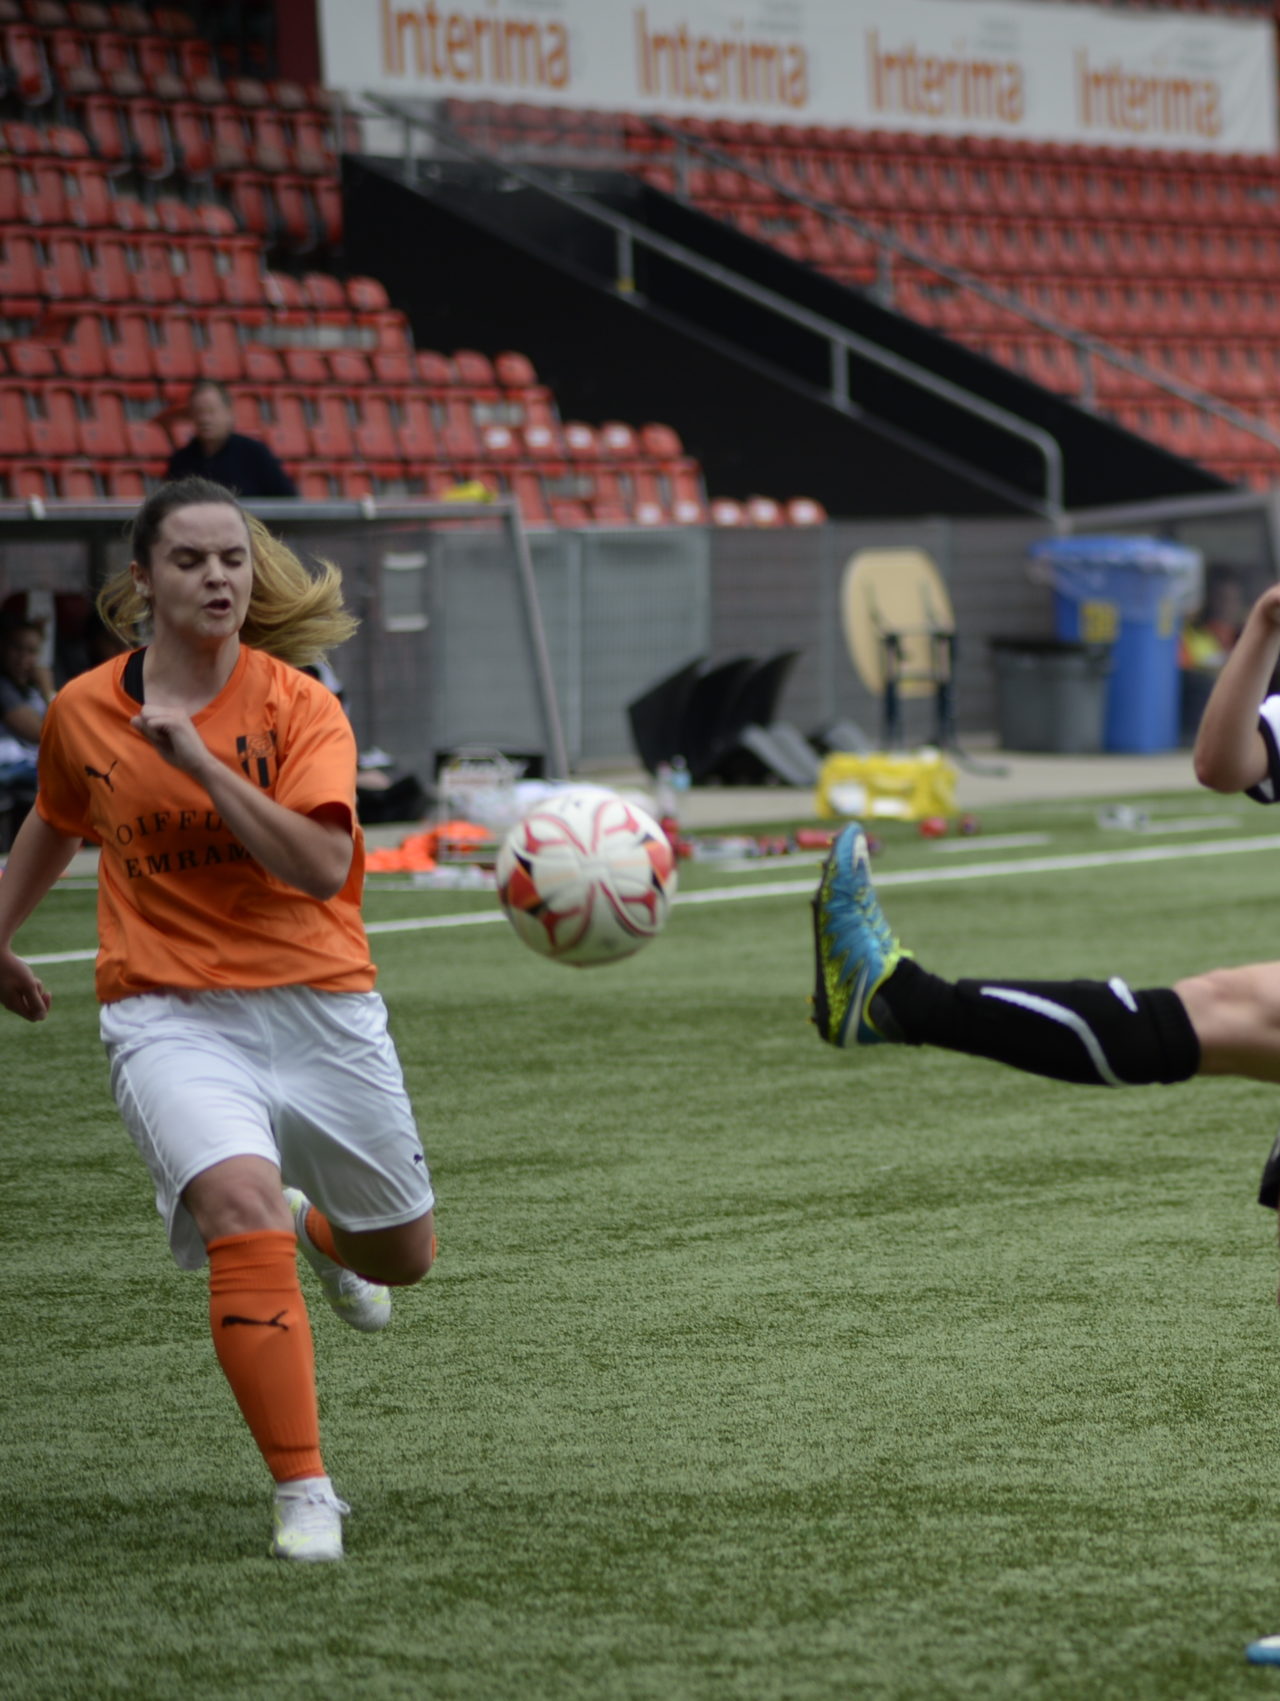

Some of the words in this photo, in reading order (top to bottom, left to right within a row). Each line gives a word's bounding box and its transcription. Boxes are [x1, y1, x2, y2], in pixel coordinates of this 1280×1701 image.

[379, 0, 571, 90] Interima
[632, 5, 809, 108] Interima
[866, 28, 1025, 124] Interima
[1074, 46, 1222, 138] Interima
